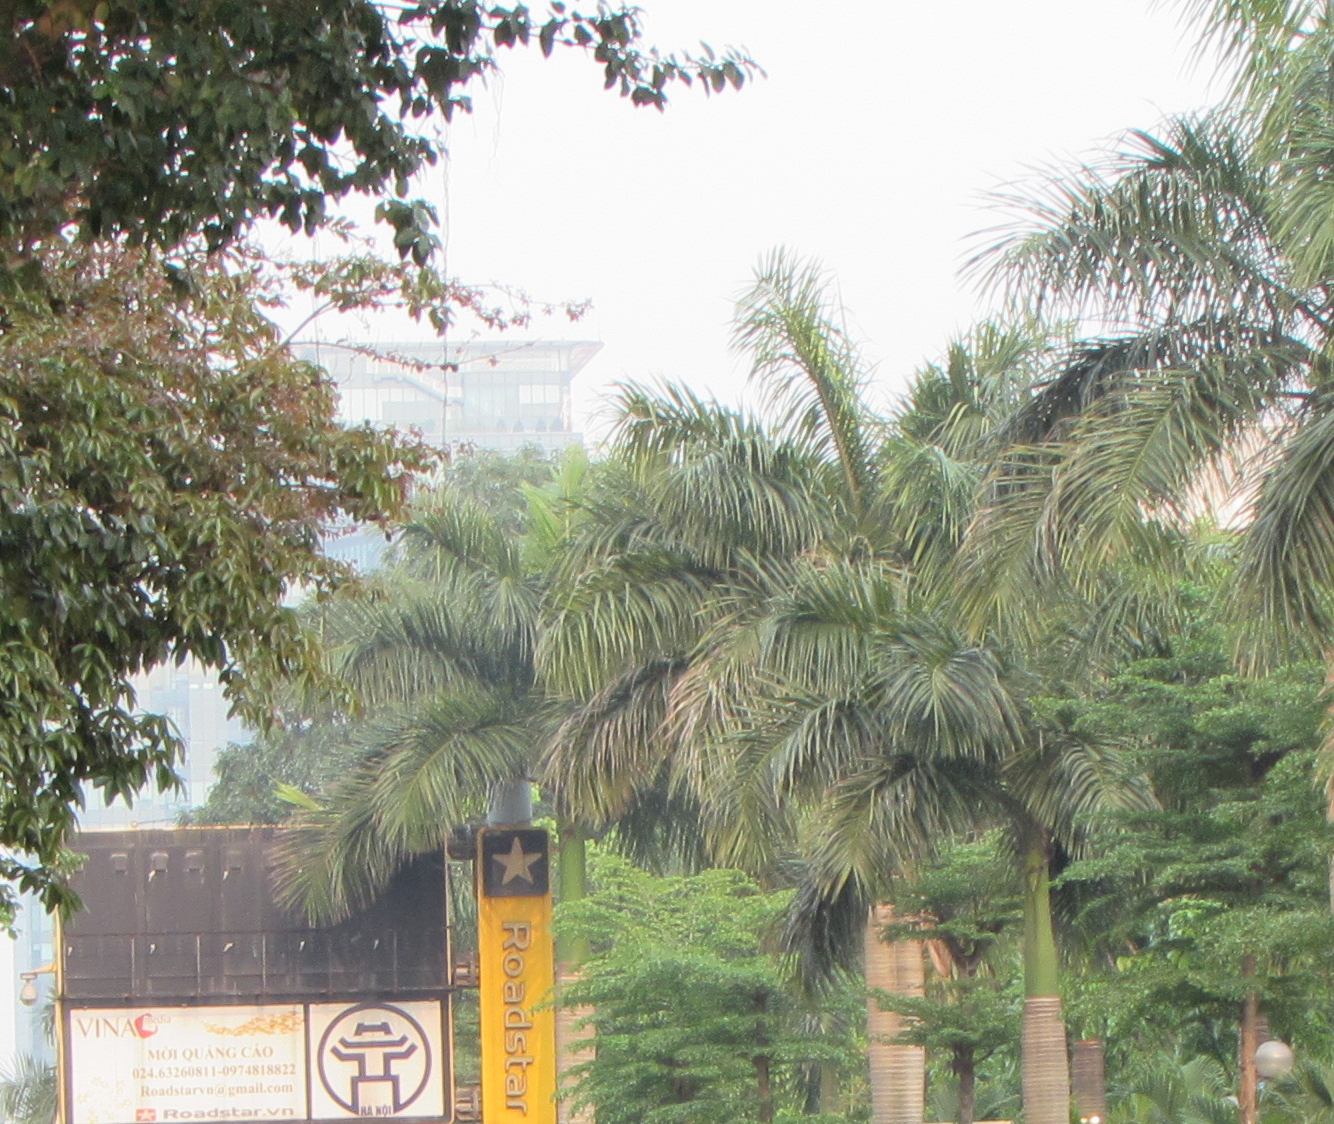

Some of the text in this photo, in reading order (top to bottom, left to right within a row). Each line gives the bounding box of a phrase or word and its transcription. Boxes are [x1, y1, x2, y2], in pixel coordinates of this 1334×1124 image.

[501, 921, 535, 1117] Roadstar
[76, 1017, 137, 1039] VINA
[241, 1045, 274, 1059] CÁO
[140, 1082, 294, 1098] Roadstarvn@gmail.com
[163, 1107, 295, 1120] Roadstar.vn
